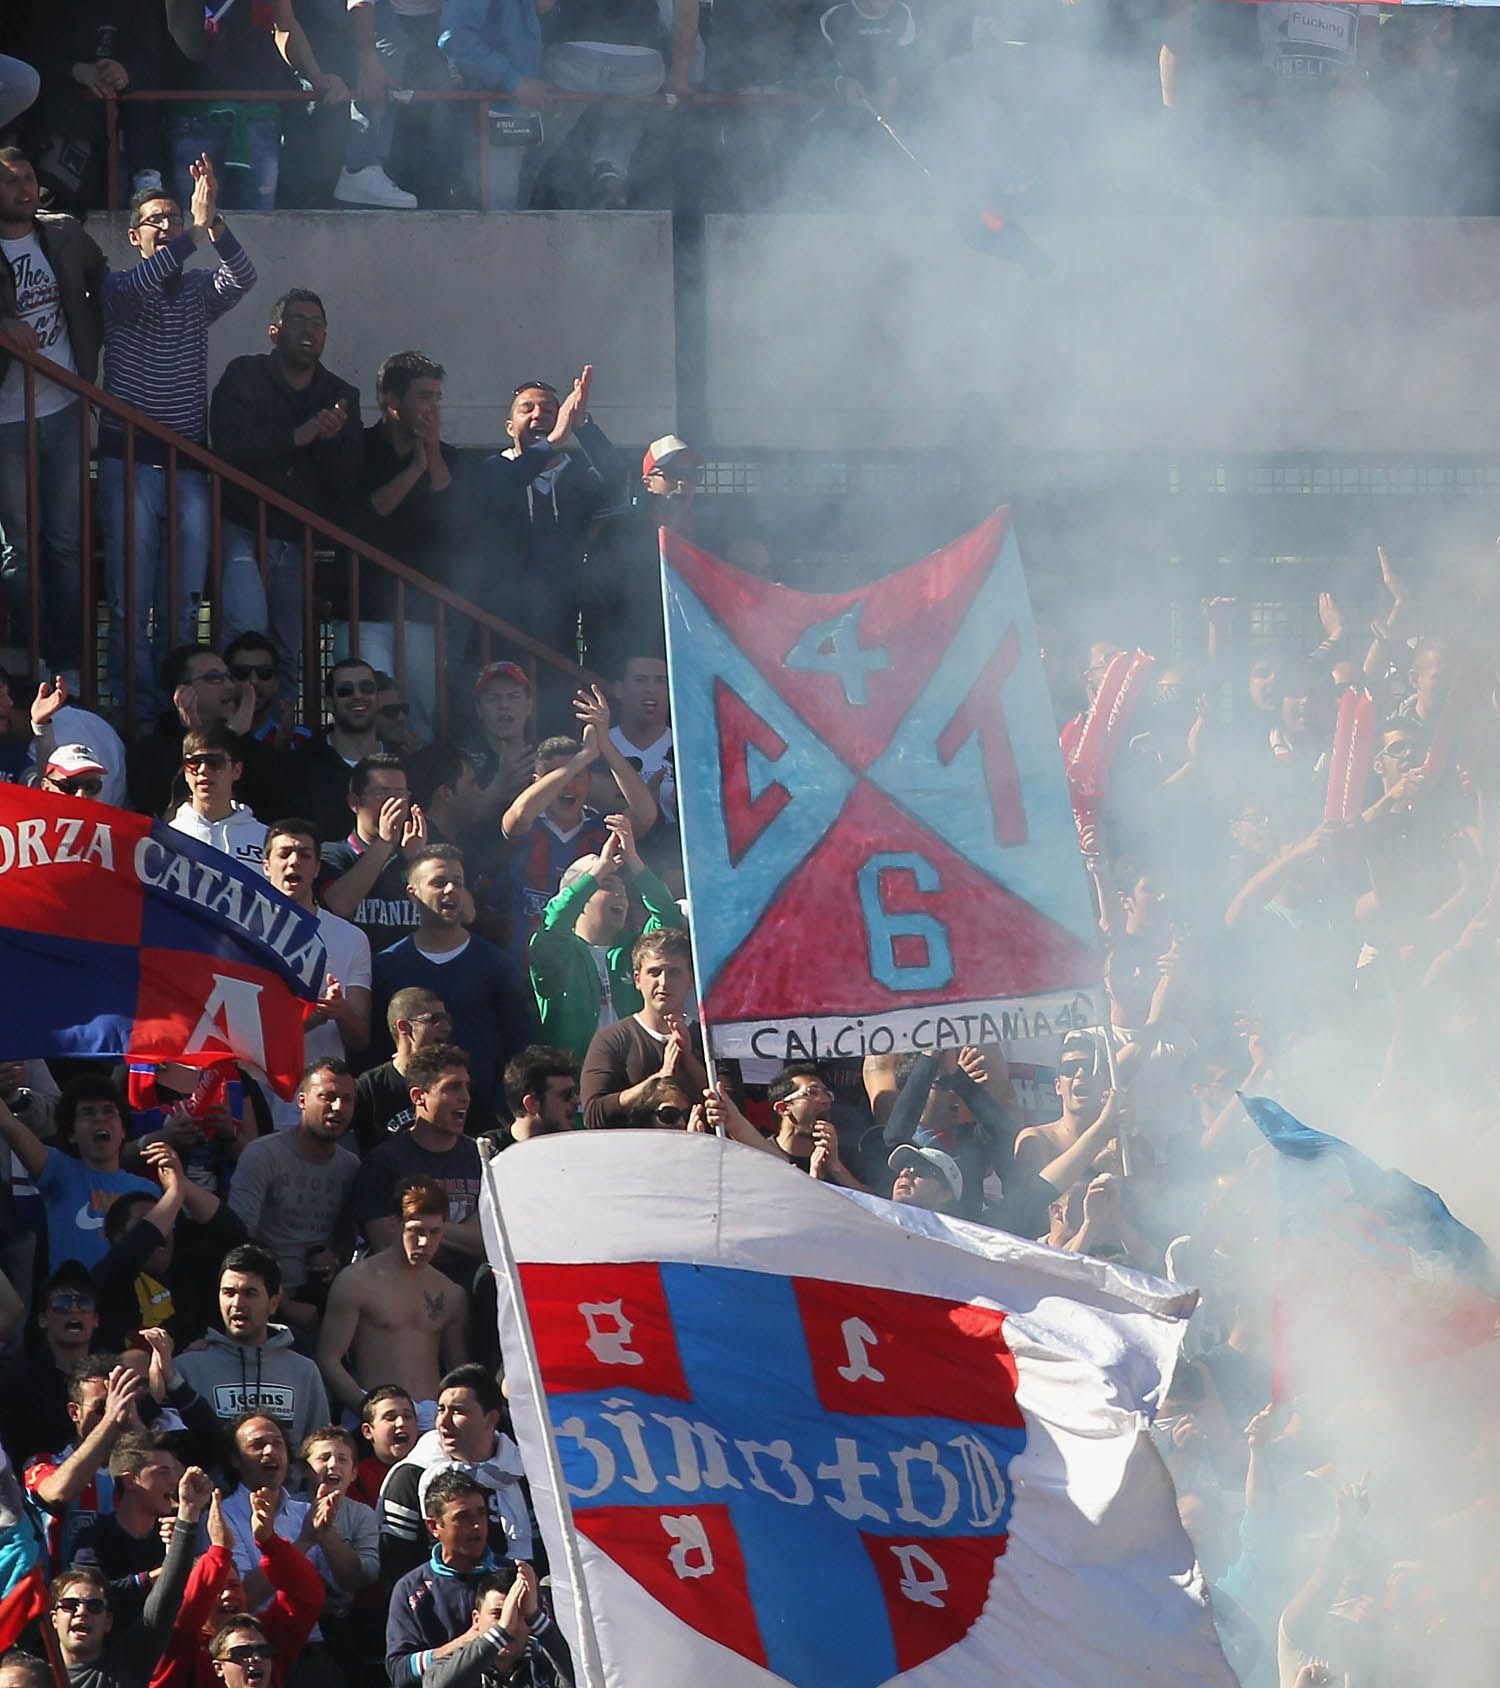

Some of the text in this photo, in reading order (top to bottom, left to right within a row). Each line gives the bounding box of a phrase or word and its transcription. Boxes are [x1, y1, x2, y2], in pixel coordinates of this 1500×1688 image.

[1292, 12, 1344, 38] Fucking
[784, 598, 893, 706] 4
[133, 836, 327, 988] CATANIA
[855, 851, 956, 992] 6
[183, 973, 268, 1074] A
[228, 1389, 285, 1408] jeans
